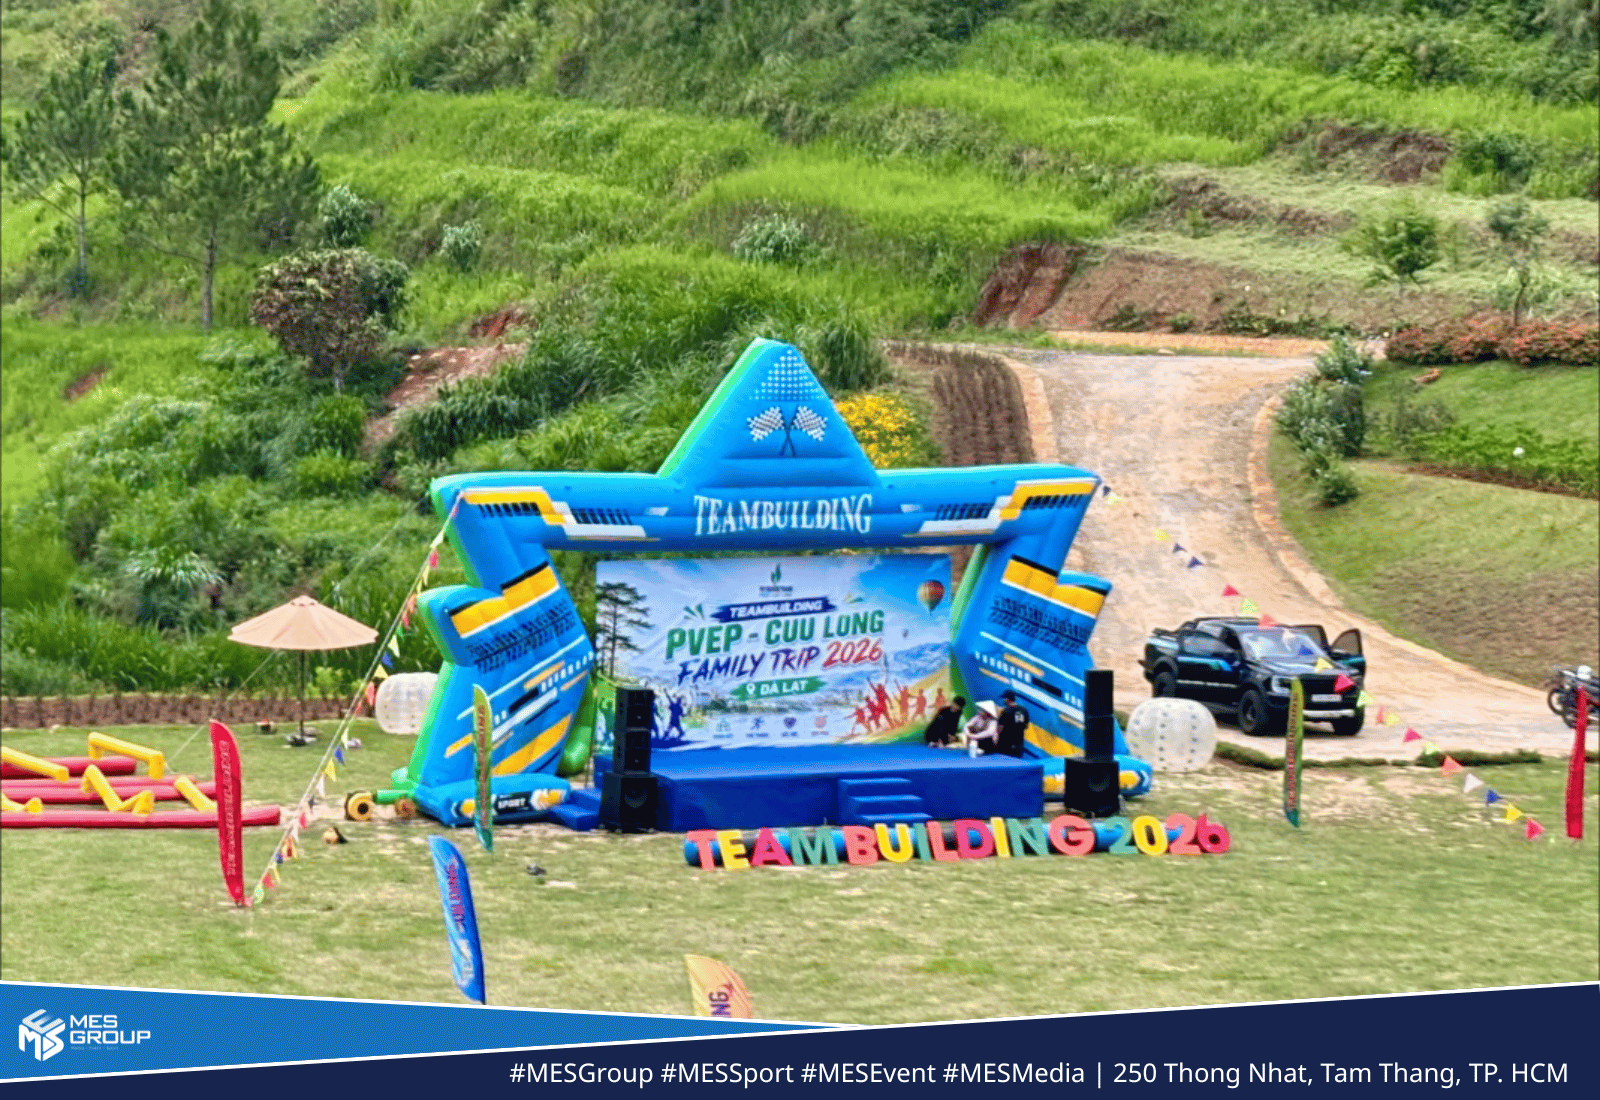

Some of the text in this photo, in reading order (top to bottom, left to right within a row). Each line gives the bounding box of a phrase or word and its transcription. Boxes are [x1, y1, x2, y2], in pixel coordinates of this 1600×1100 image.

[694, 493, 873, 536] TEAMBUILDING
[730, 600, 824, 618] TEAMBUILDING
[665, 623, 743, 660] PVEP
[765, 617, 815, 645] CUU
[823, 609, 885, 638] LONG
[677, 637, 884, 686] FAMILY TRIP 2026
[1108, 812, 1232, 857] 2026
